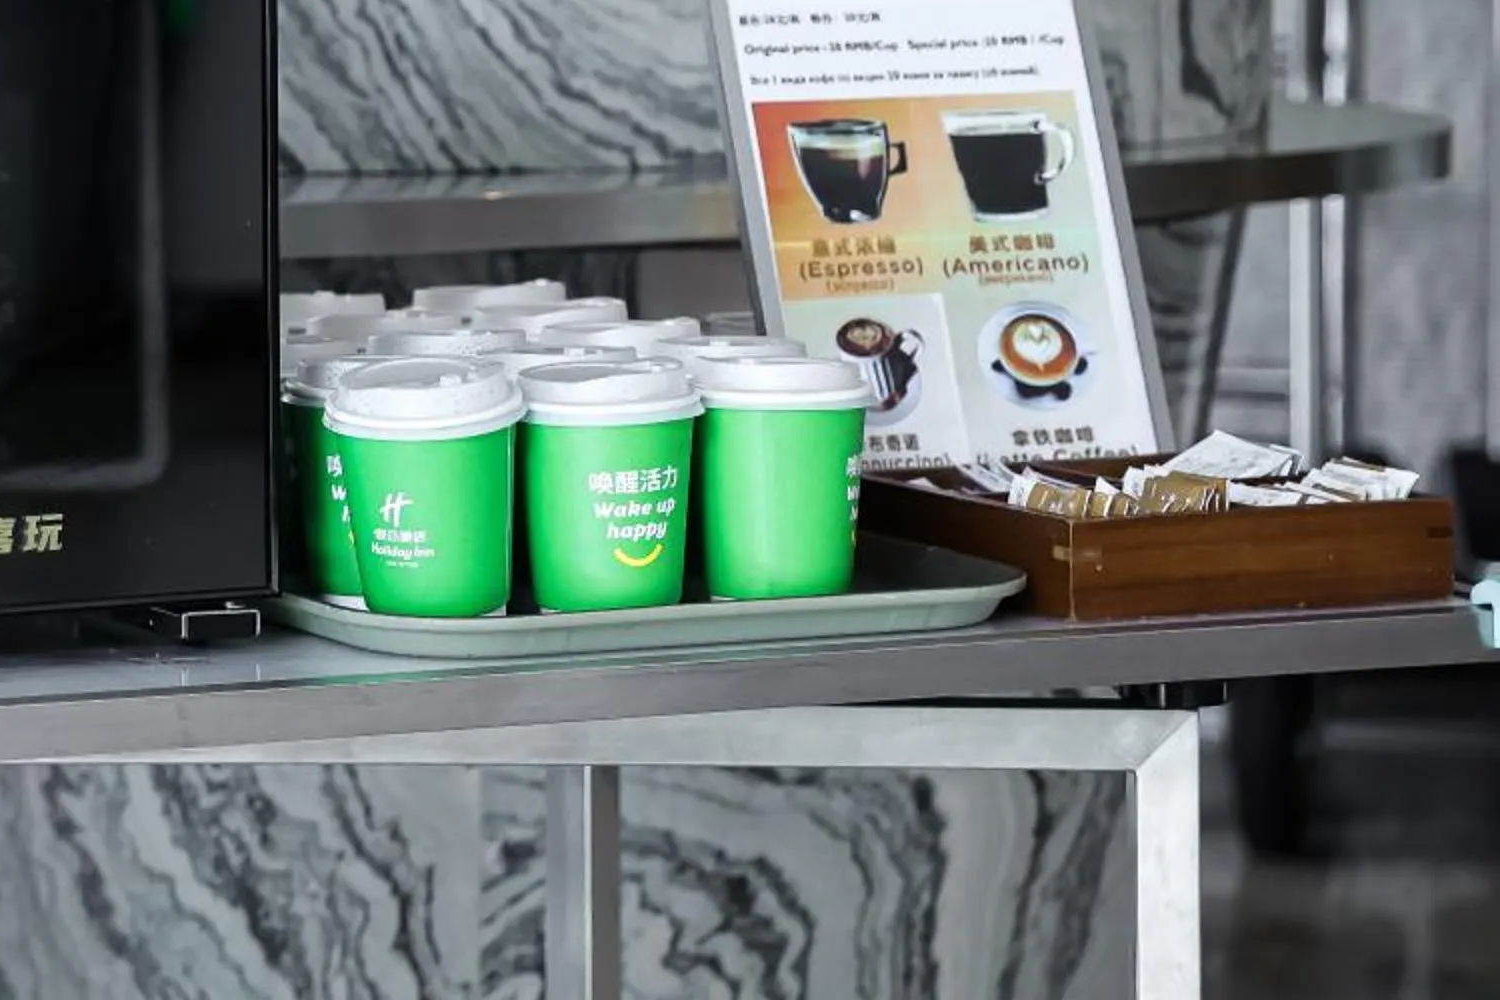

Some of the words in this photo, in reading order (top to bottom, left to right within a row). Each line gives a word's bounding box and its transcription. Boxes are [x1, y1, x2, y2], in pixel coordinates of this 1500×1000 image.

[799, 256, 924, 282] (Espresso)
[942, 252, 1090, 279] (Americano)
[867, 433, 920, 453] 布奇诺
[588, 465, 679, 495] 唤醒活力
[592, 500, 652, 519] Wake
[656, 498, 676, 517] up
[605, 521, 668, 543] happy
